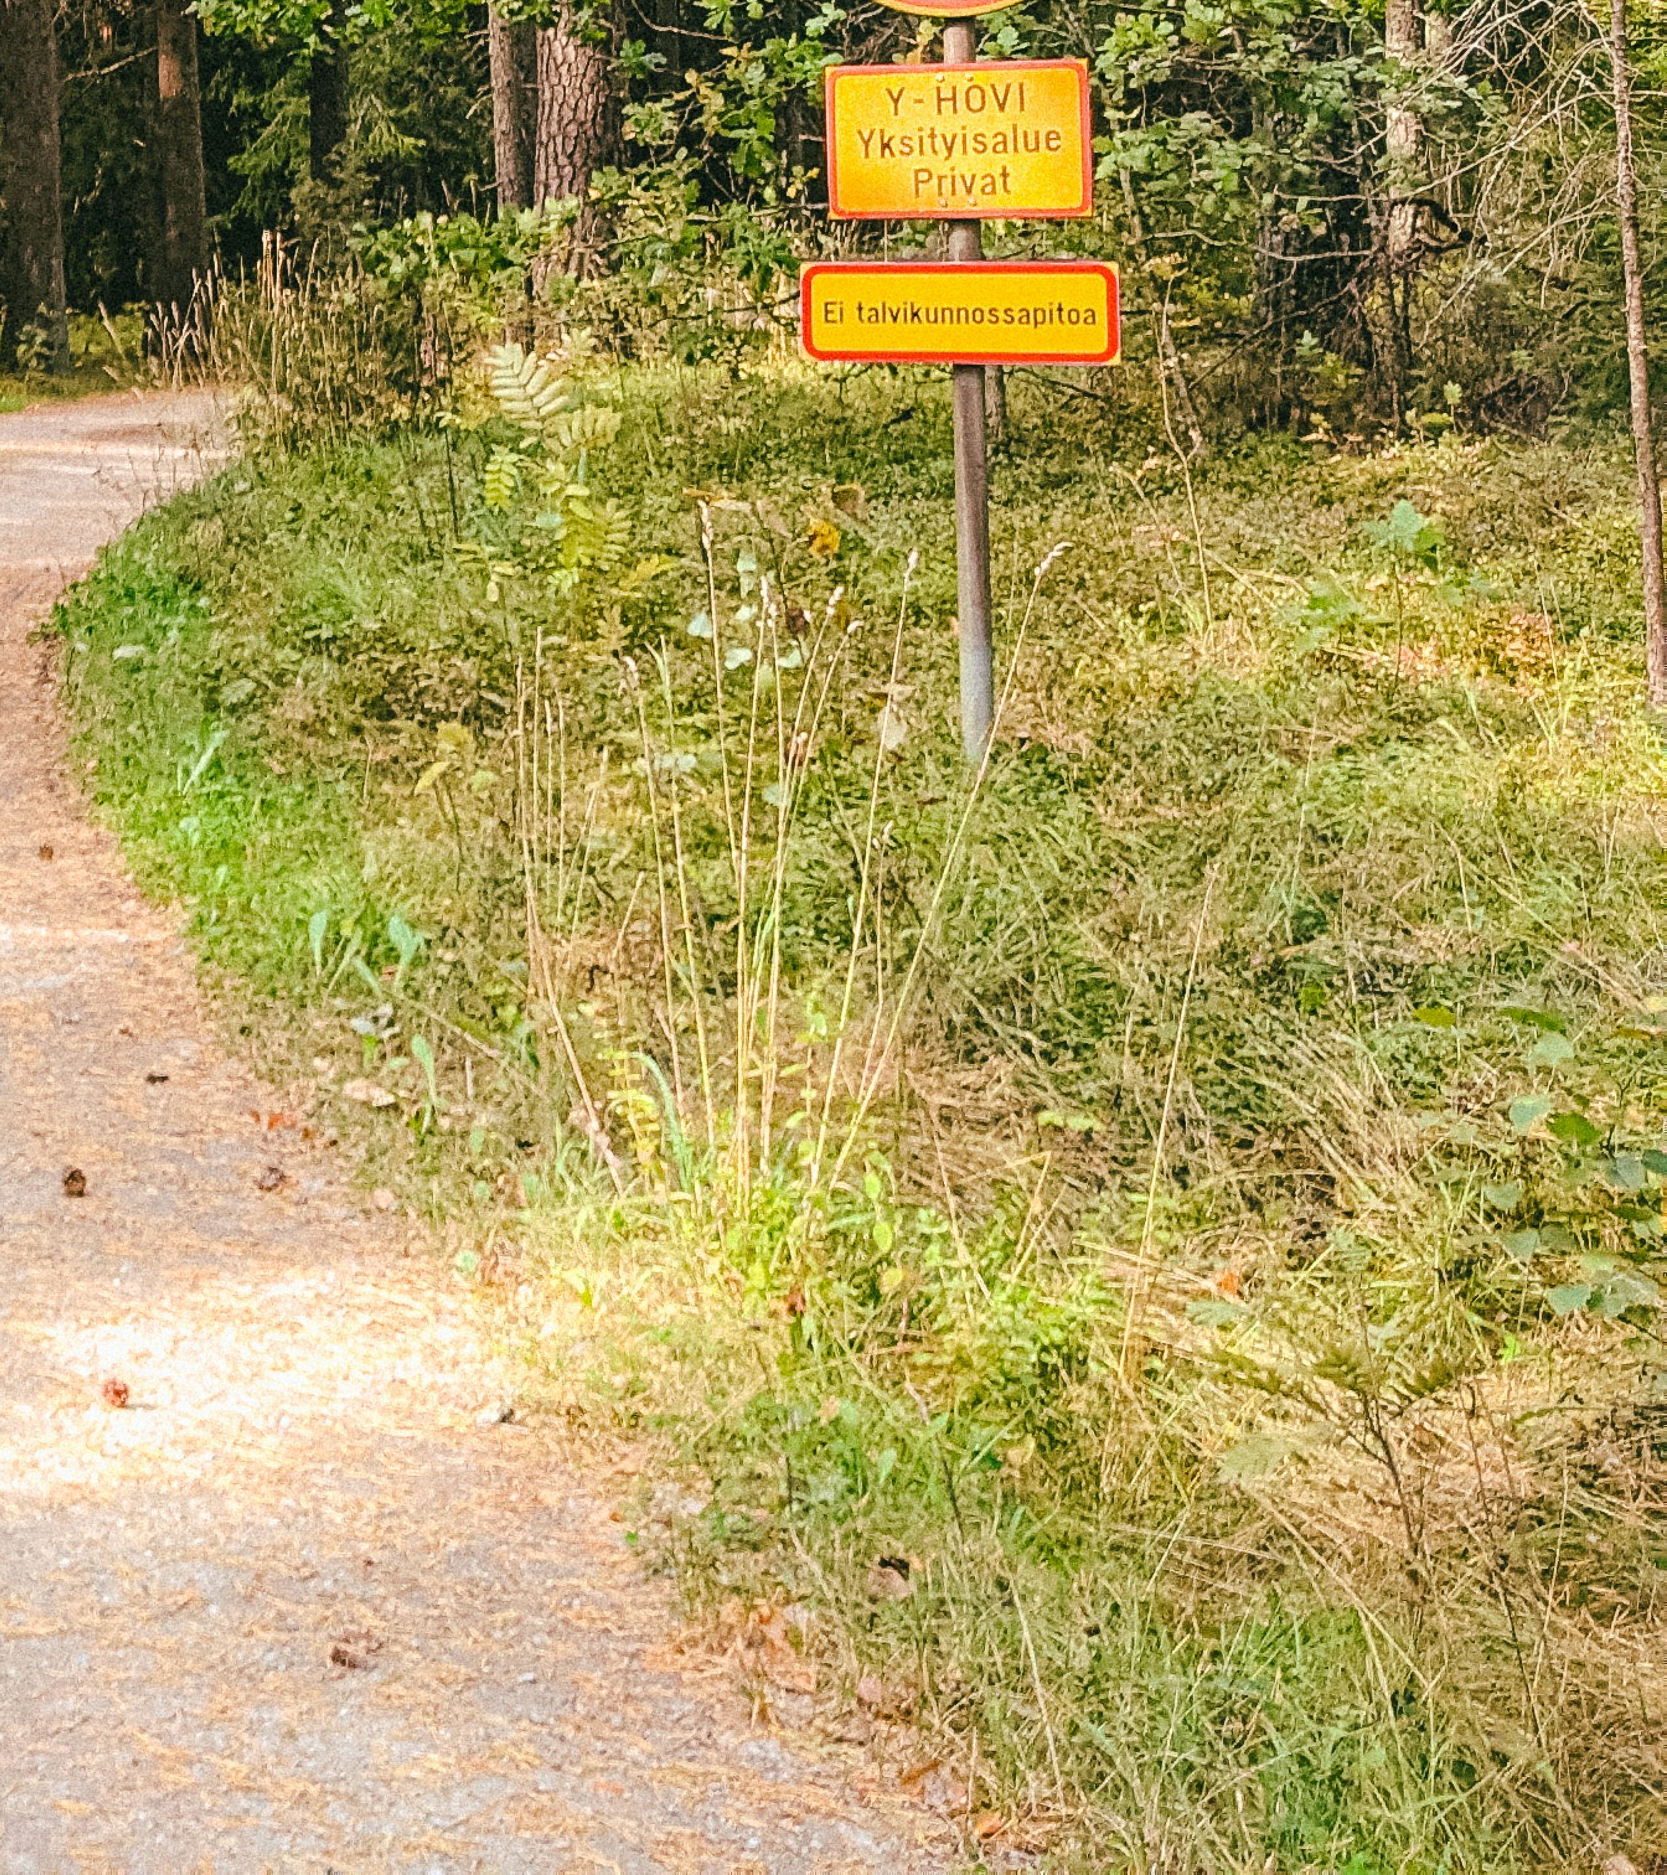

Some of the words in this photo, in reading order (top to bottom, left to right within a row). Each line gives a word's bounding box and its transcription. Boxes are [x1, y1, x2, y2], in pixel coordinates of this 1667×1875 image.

[855, 123, 1063, 161] Yksityisalue
[912, 165, 1013, 199] Privat
[823, 301, 845, 324] Ei
[857, 301, 1097, 329] talvikunnossapitoa
